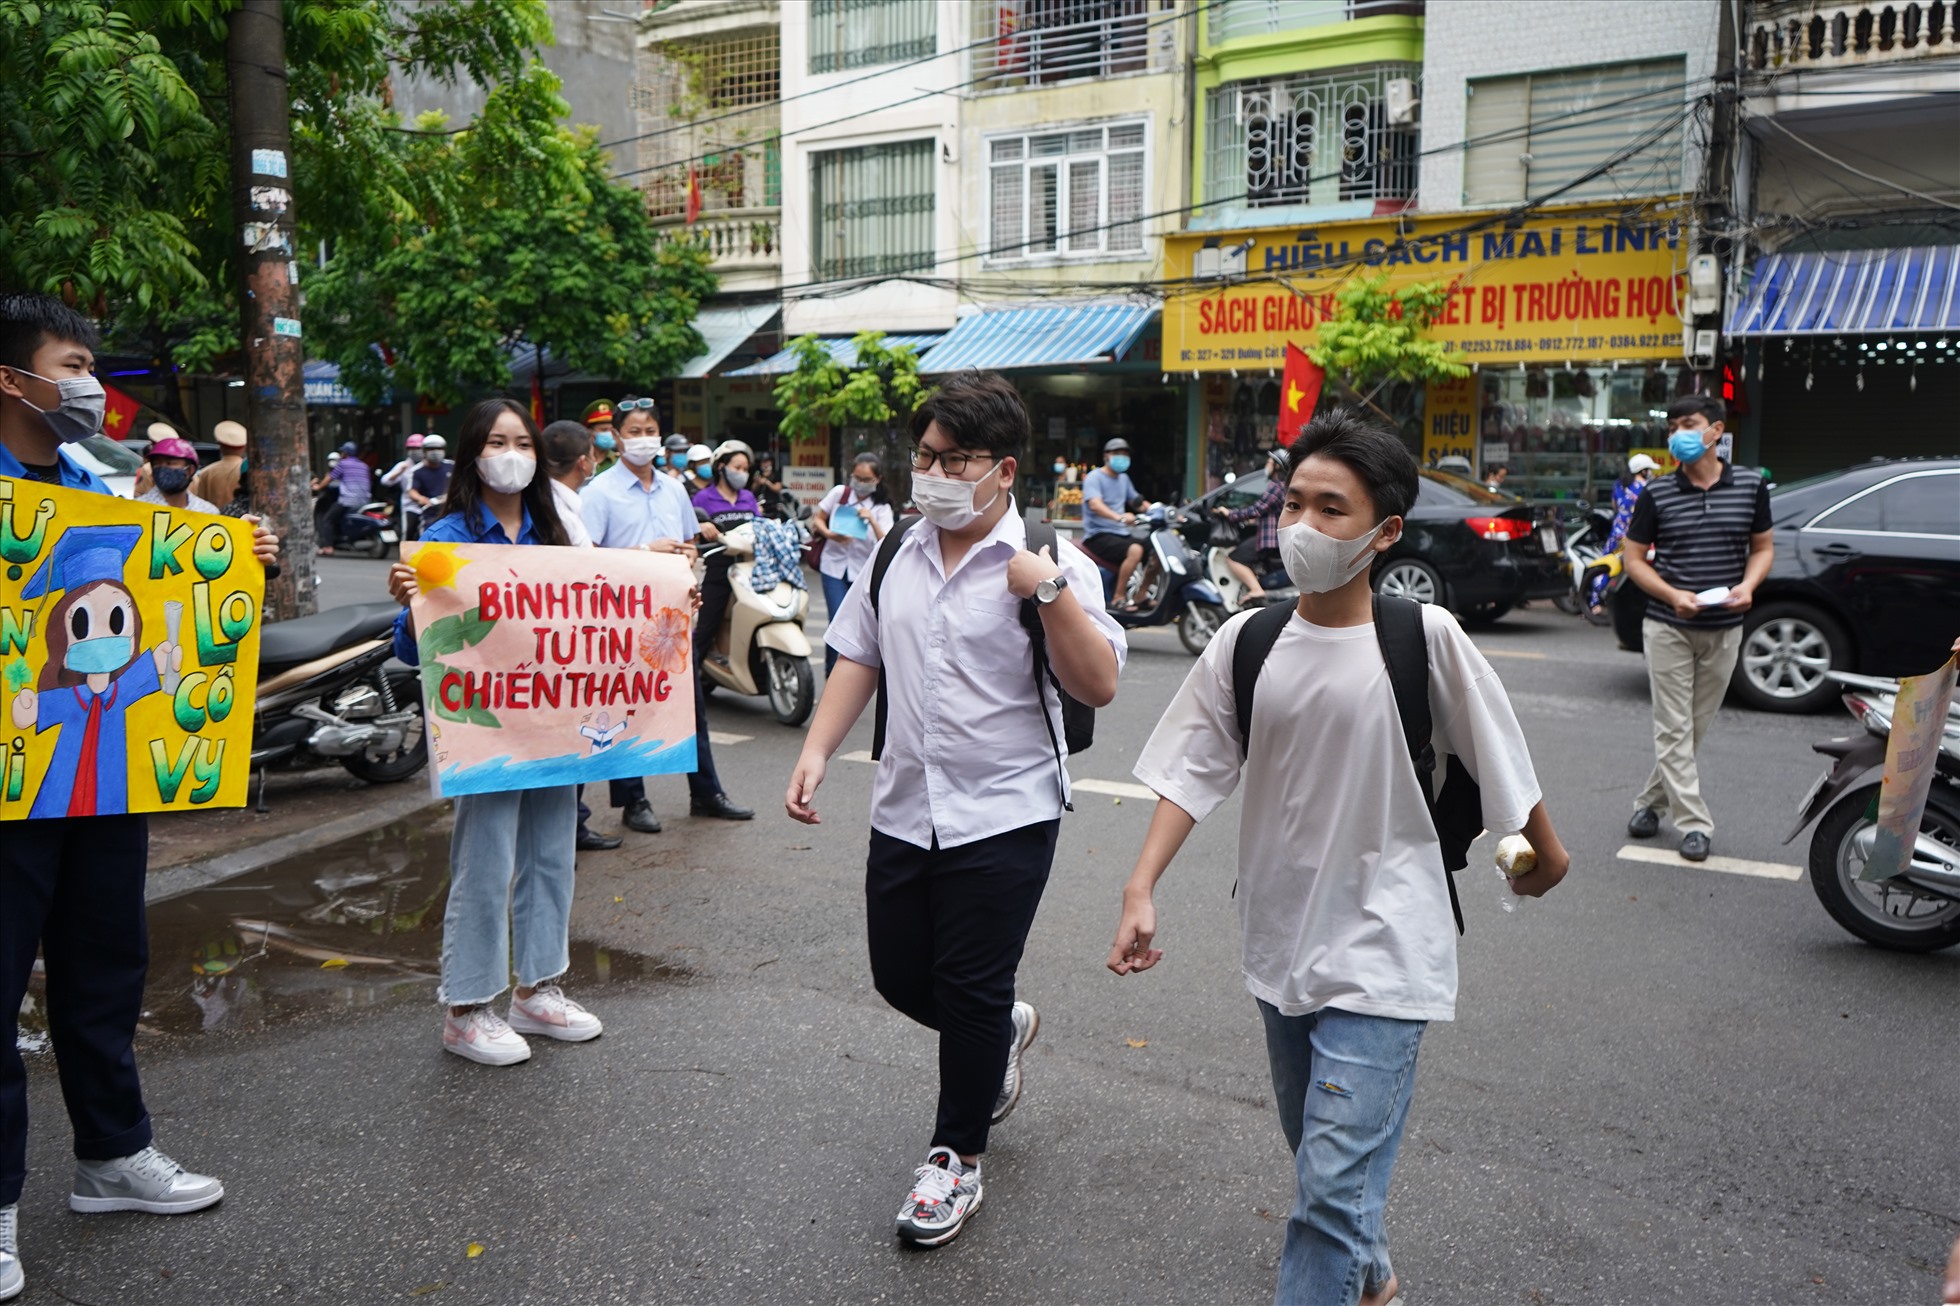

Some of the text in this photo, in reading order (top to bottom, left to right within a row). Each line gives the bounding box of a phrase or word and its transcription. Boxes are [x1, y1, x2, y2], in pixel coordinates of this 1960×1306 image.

[1482, 227, 1563, 261] MAI
[1575, 218, 1679, 256] LINH
[1199, 293, 1258, 335] SÁCH
[1481, 284, 1506, 330] BỊ
[1512, 270, 1621, 323] TRƯỜNG
[1626, 273, 1684, 325] HỌC
[1432, 409, 1470, 439] HIỆU
[149, 511, 235, 580] KO
[478, 567, 652, 622] BÌNH TĨNH
[193, 581, 255, 667] LO
[532, 624, 634, 671] TỰ TIN
[438, 661, 673, 713] CHIẾN THẮNG
